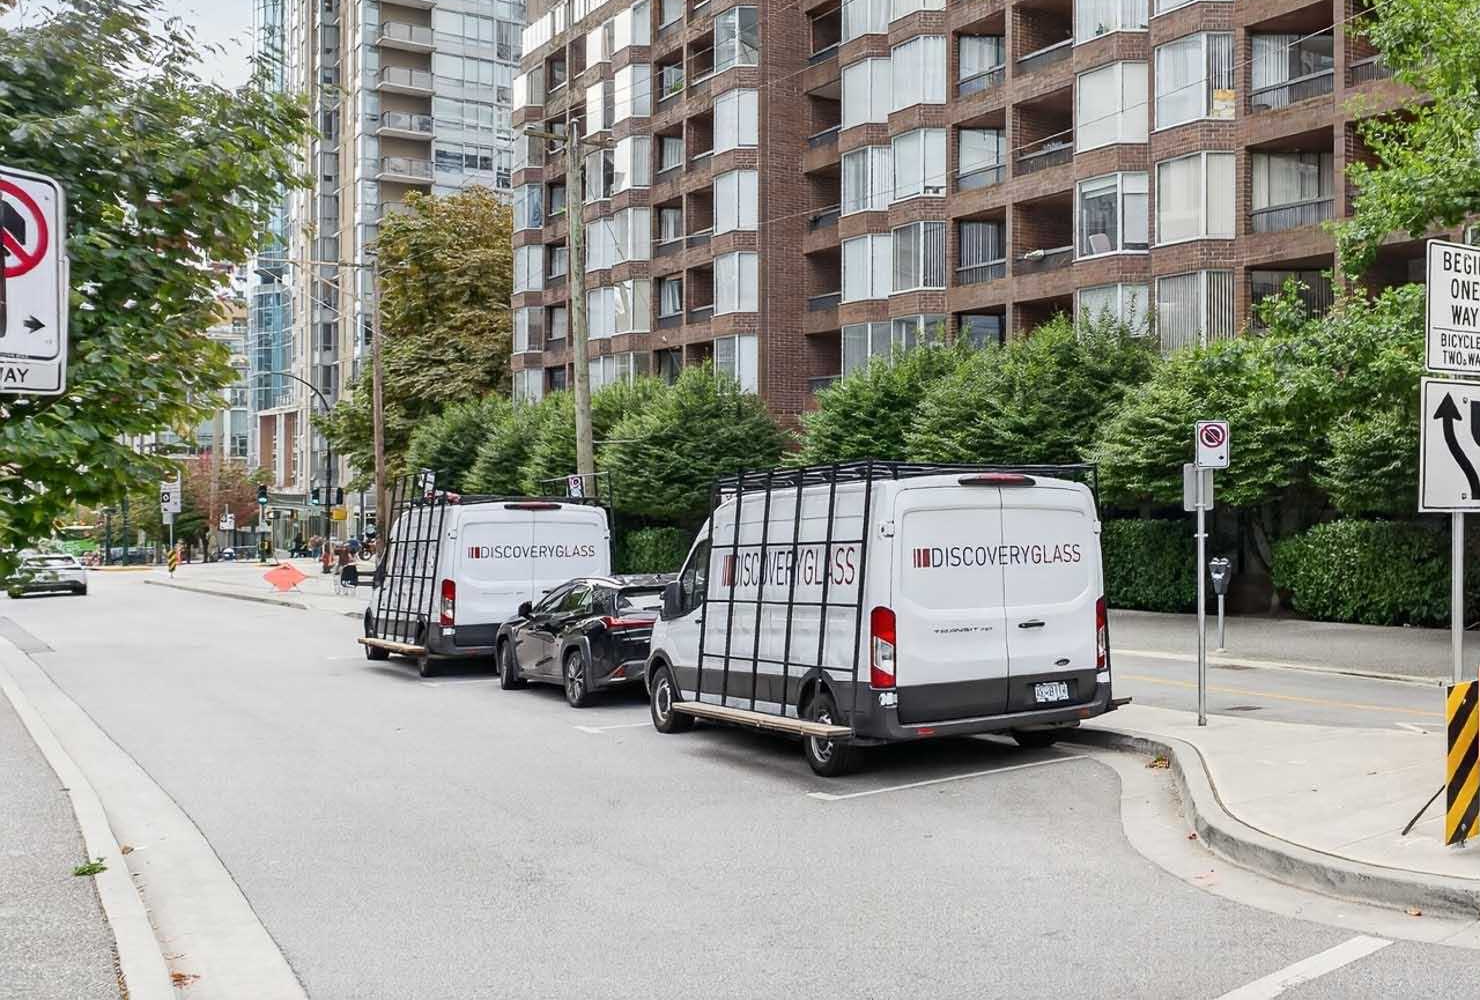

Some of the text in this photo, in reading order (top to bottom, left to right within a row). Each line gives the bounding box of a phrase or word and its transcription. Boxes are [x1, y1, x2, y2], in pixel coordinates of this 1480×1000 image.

[1450, 278, 1480, 301] ONE
[1452, 304, 1479, 327] WAY
[1443, 350, 1462, 365] TWO
[0, 367, 29, 383] AY
[480, 544, 596, 559] DISCOVERYGLASS
[931, 543, 1082, 569] DISCOVERYGLASS
